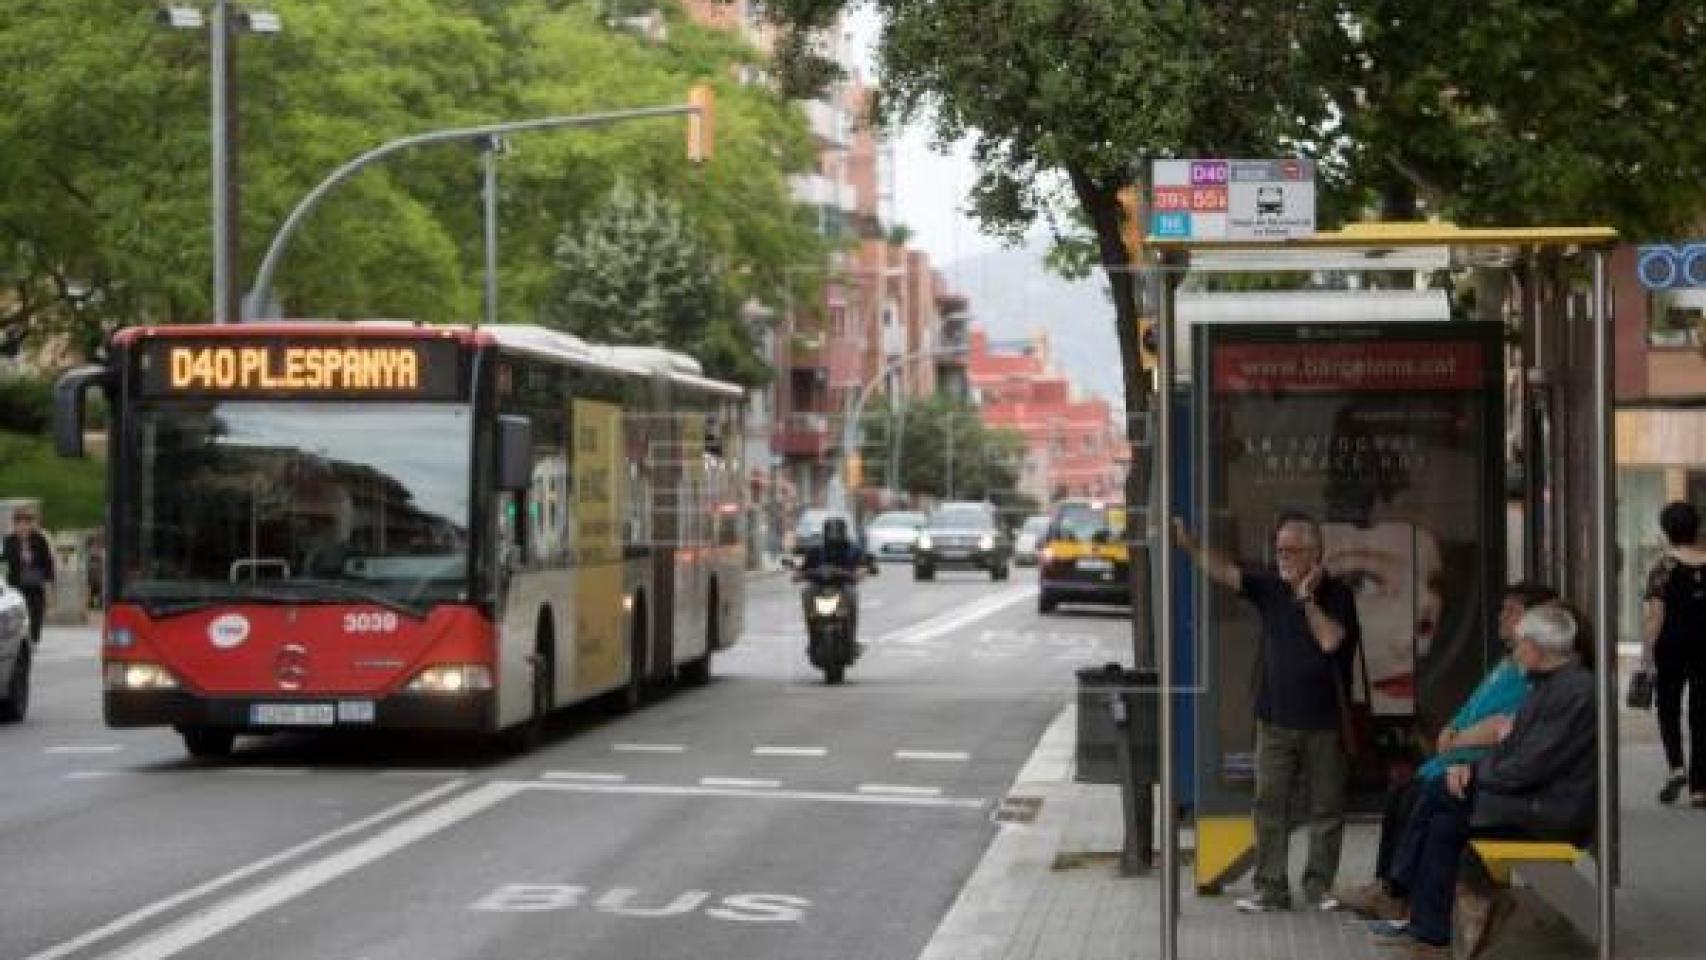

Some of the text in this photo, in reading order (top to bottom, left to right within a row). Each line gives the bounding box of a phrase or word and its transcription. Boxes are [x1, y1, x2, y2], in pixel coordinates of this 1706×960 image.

[1193, 164, 1226, 182] D40
[172, 348, 236, 389] D40
[468, 883, 812, 922] BUS
